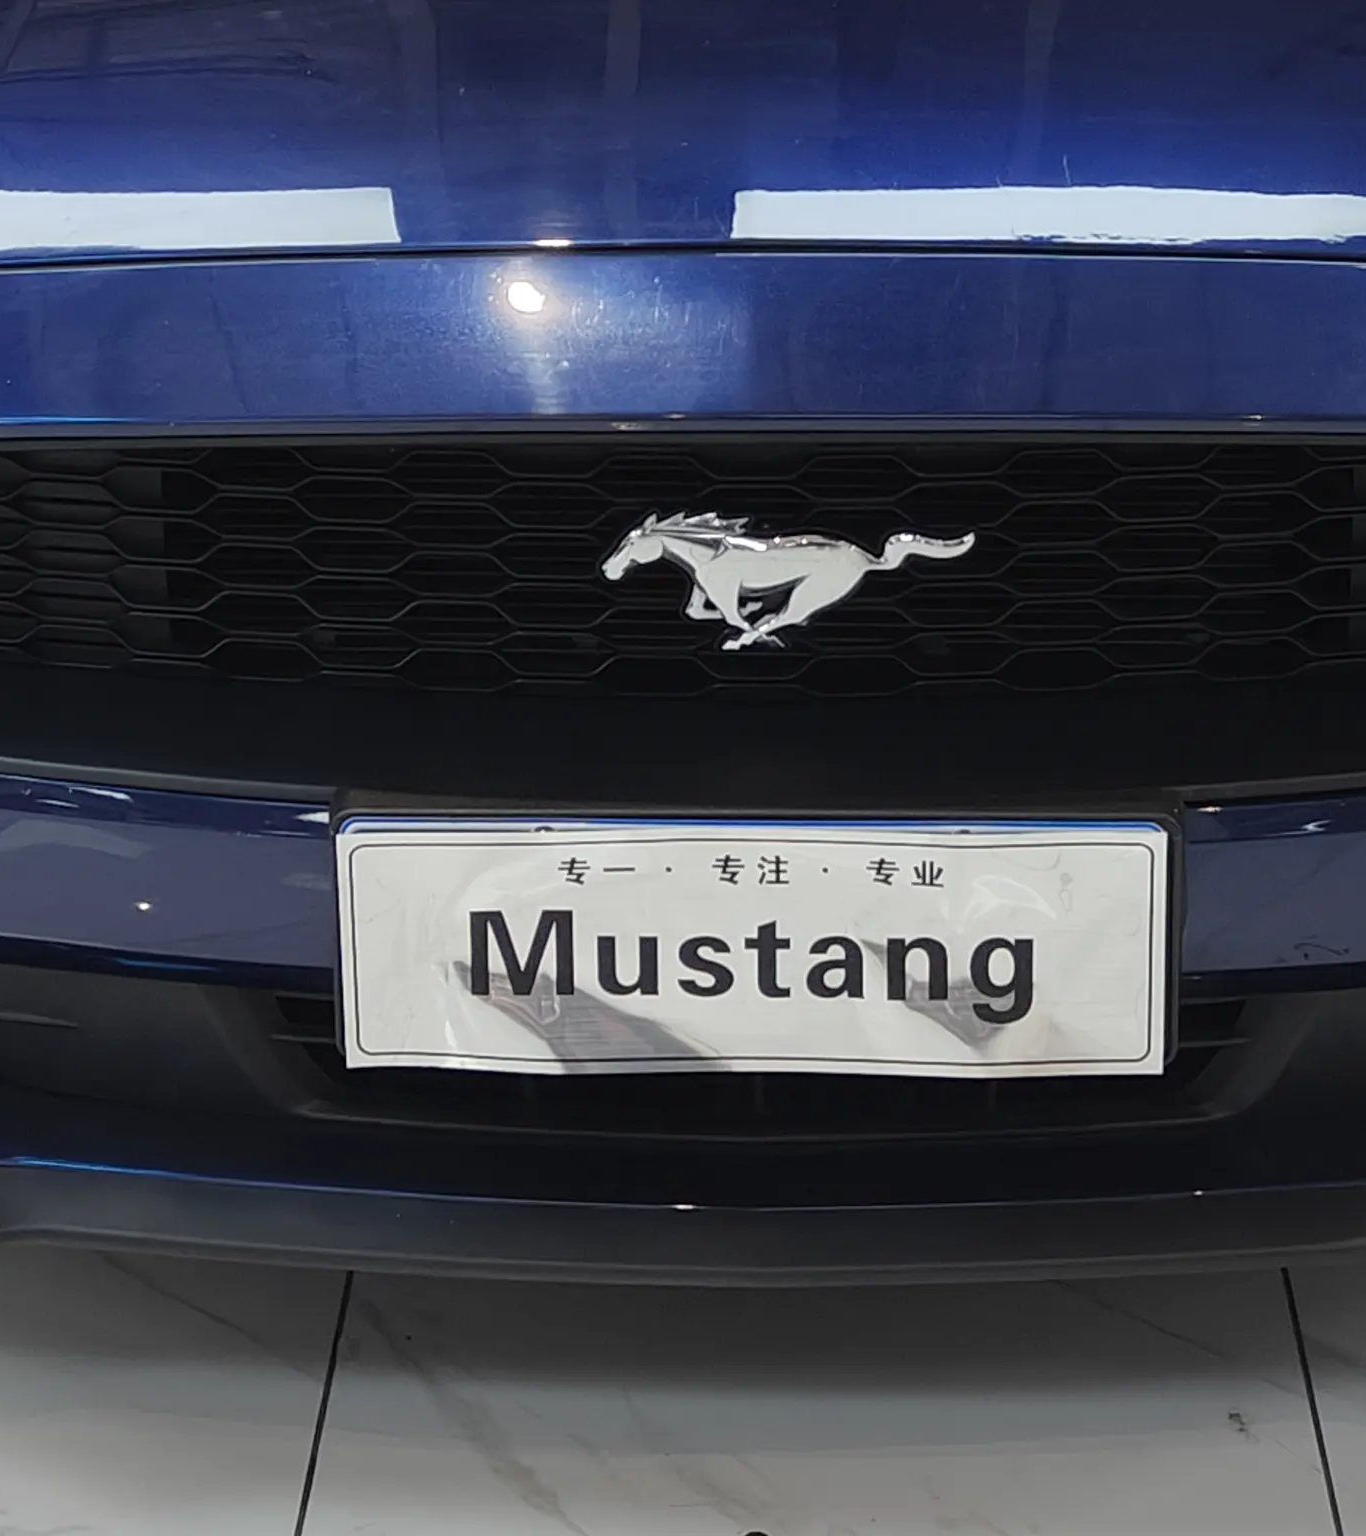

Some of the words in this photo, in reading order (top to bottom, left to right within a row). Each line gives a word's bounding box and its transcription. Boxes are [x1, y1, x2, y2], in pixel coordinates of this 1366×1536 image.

[557, 856, 636, 886] 专一
[711, 854, 791, 886] 专注
[865, 858, 945, 889] 专业
[468, 908, 1035, 1025] Mustang
